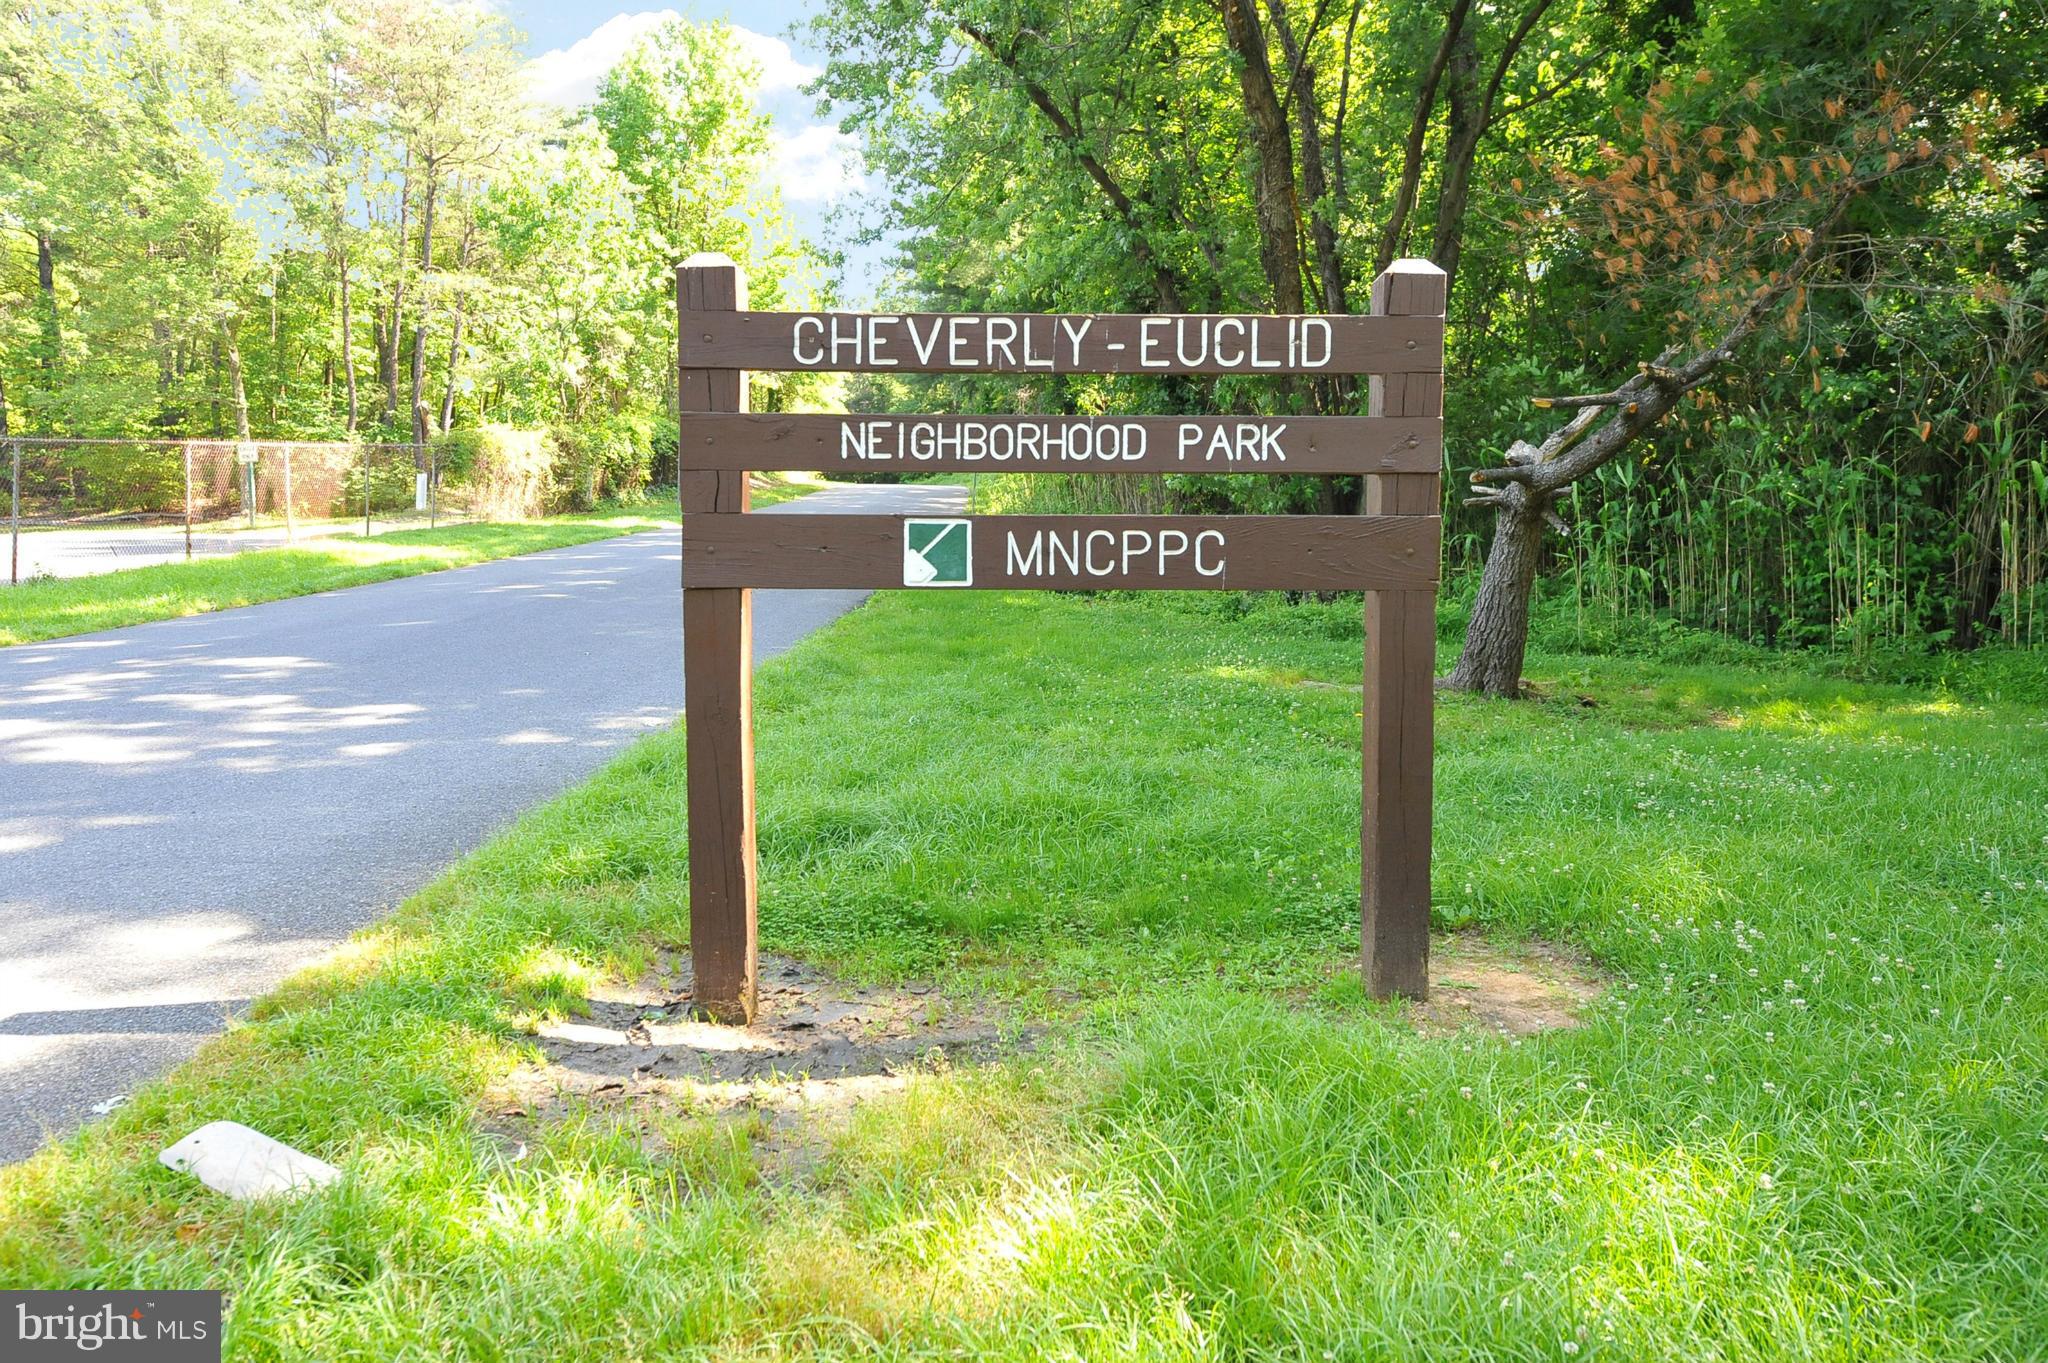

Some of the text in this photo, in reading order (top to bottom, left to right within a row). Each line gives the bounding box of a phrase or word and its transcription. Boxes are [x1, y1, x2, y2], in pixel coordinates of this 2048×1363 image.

[841, 421, 1287, 462] NEIGHBORHOOD PARK
[1006, 530, 1225, 576] MNCPPC
